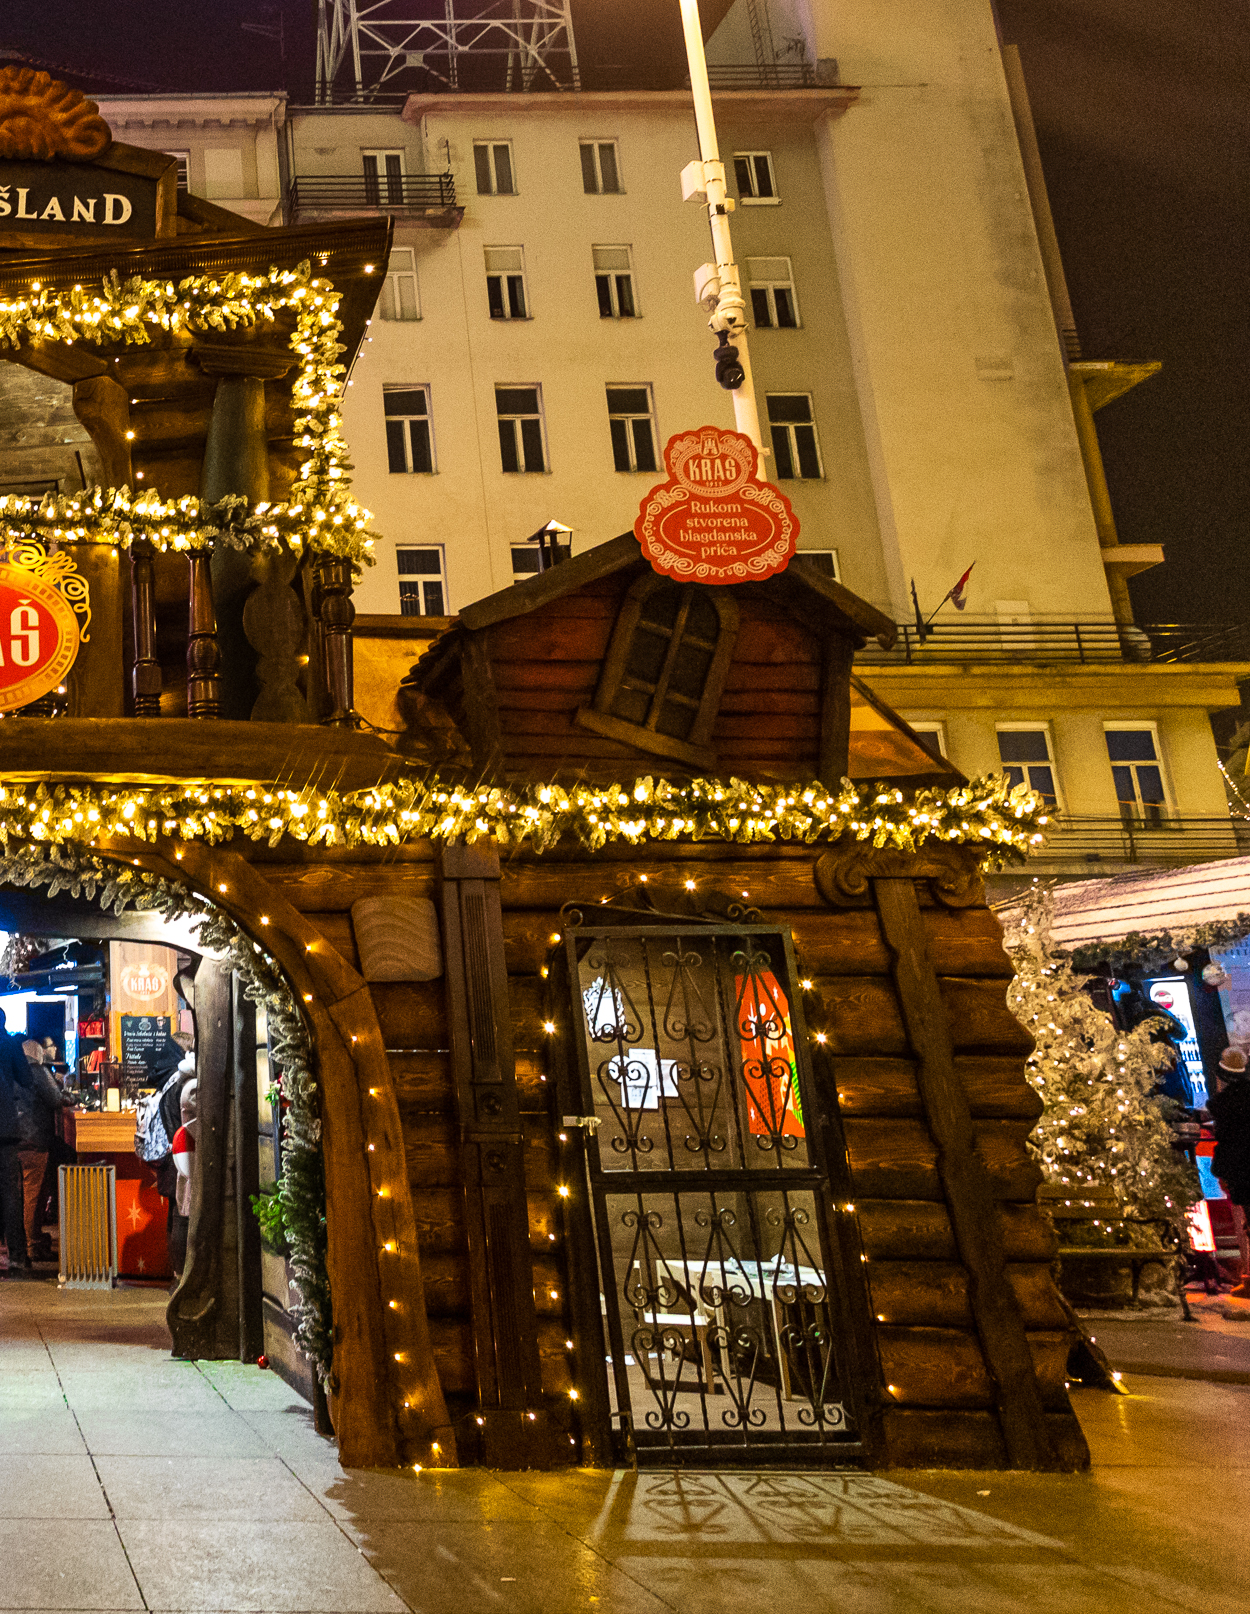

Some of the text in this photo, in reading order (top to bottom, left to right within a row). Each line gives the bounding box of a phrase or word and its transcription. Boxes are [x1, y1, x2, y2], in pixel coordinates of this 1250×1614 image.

[689, 456, 736, 480] KRAŠ
[691, 501, 741, 513] Rukom
[686, 517, 748, 528] stvorena
[680, 529, 757, 543] blagdanska
[701, 544, 737, 559] priča
